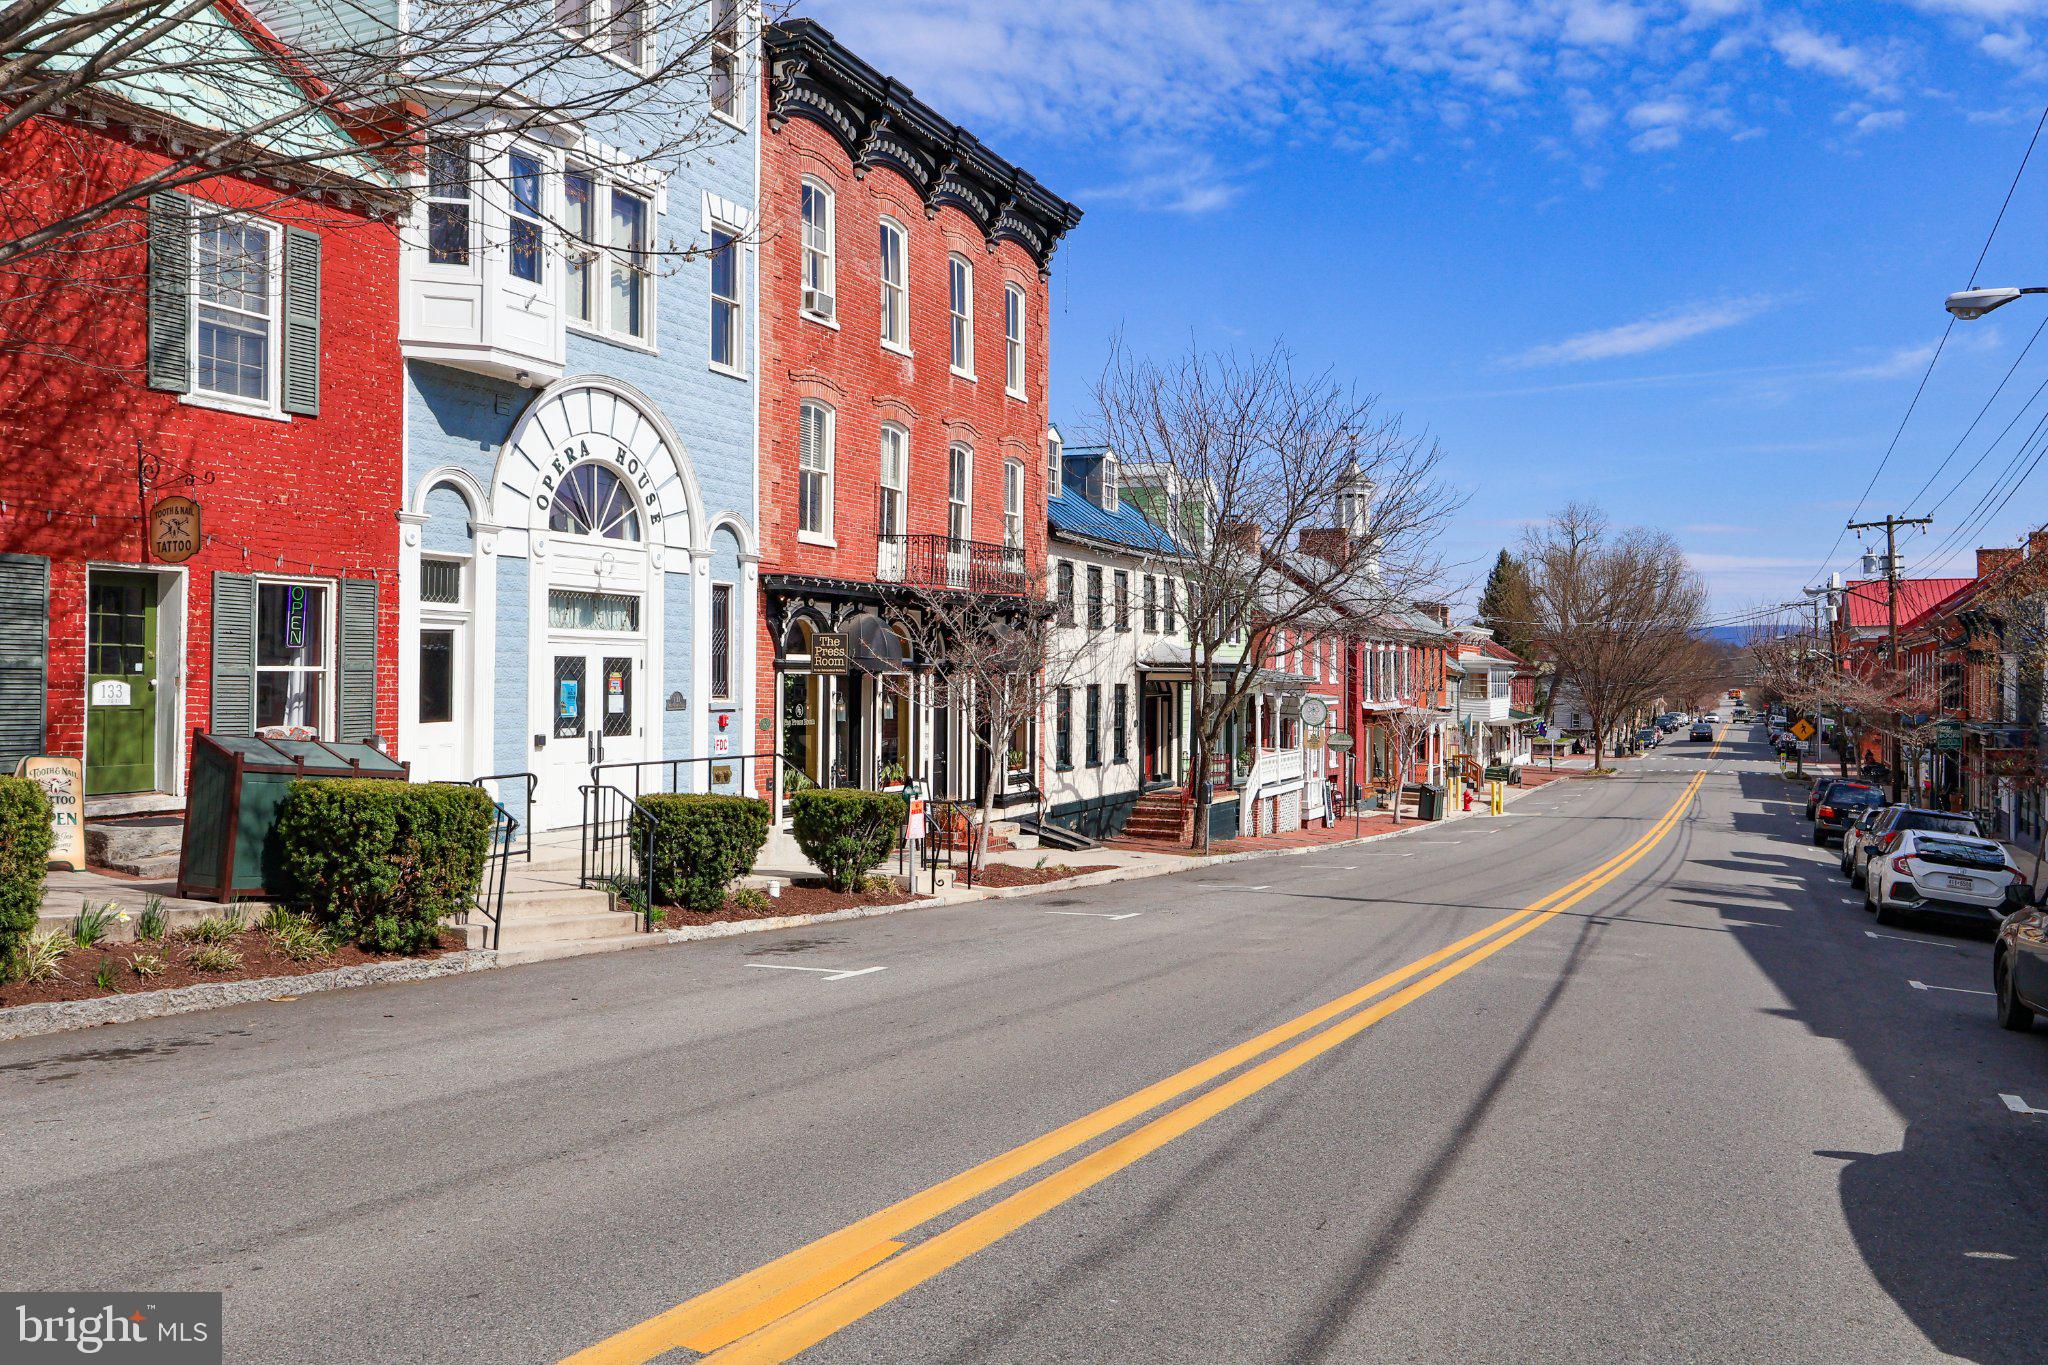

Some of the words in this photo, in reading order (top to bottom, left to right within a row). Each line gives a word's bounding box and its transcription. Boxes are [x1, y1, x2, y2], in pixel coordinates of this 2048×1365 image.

[536, 439, 590, 511] OPERA
[615, 446, 662, 525] HOUSE
[155, 506, 173, 519] TOOTH
[174, 506, 180, 515] &
[180, 506, 194, 517] NAIL
[156, 540, 192, 553] TATTOO
[290, 586, 304, 645] OPEN
[819, 636, 841, 647] The
[814, 646, 845, 657] Press
[814, 657, 845, 666] Room
[101, 684, 123, 699] 133
[715, 738, 728, 751] FDC
[30, 767, 55, 778] TOOTH
[61, 766, 79, 779] NAIL
[48, 795, 76, 805] TTOO
